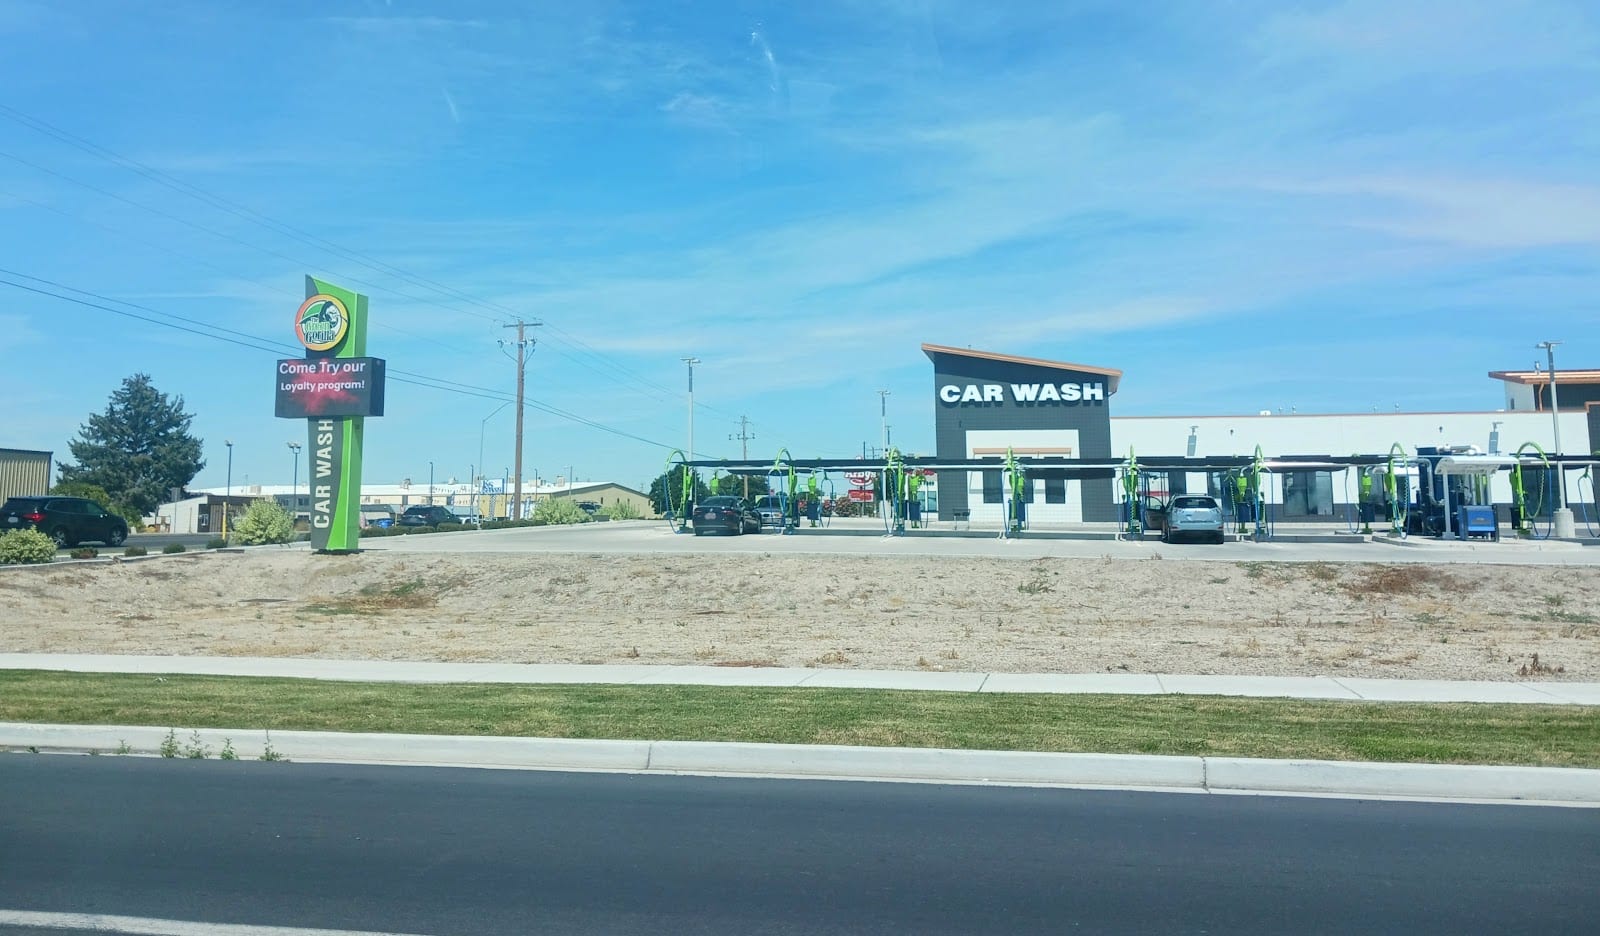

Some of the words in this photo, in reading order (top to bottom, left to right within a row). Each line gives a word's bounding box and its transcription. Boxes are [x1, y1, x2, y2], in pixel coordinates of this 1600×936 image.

[304, 330, 336, 344] Gorilla
[280, 363, 317, 375] Come
[319, 362, 340, 375] Try
[343, 362, 366, 373] our
[281, 382, 316, 392] Loyalty
[317, 380, 365, 391] program!
[939, 384, 1003, 402] CAR
[1011, 382, 1104, 401] WASH
[316, 420, 334, 478] WASH
[314, 485, 331, 529] CAR
